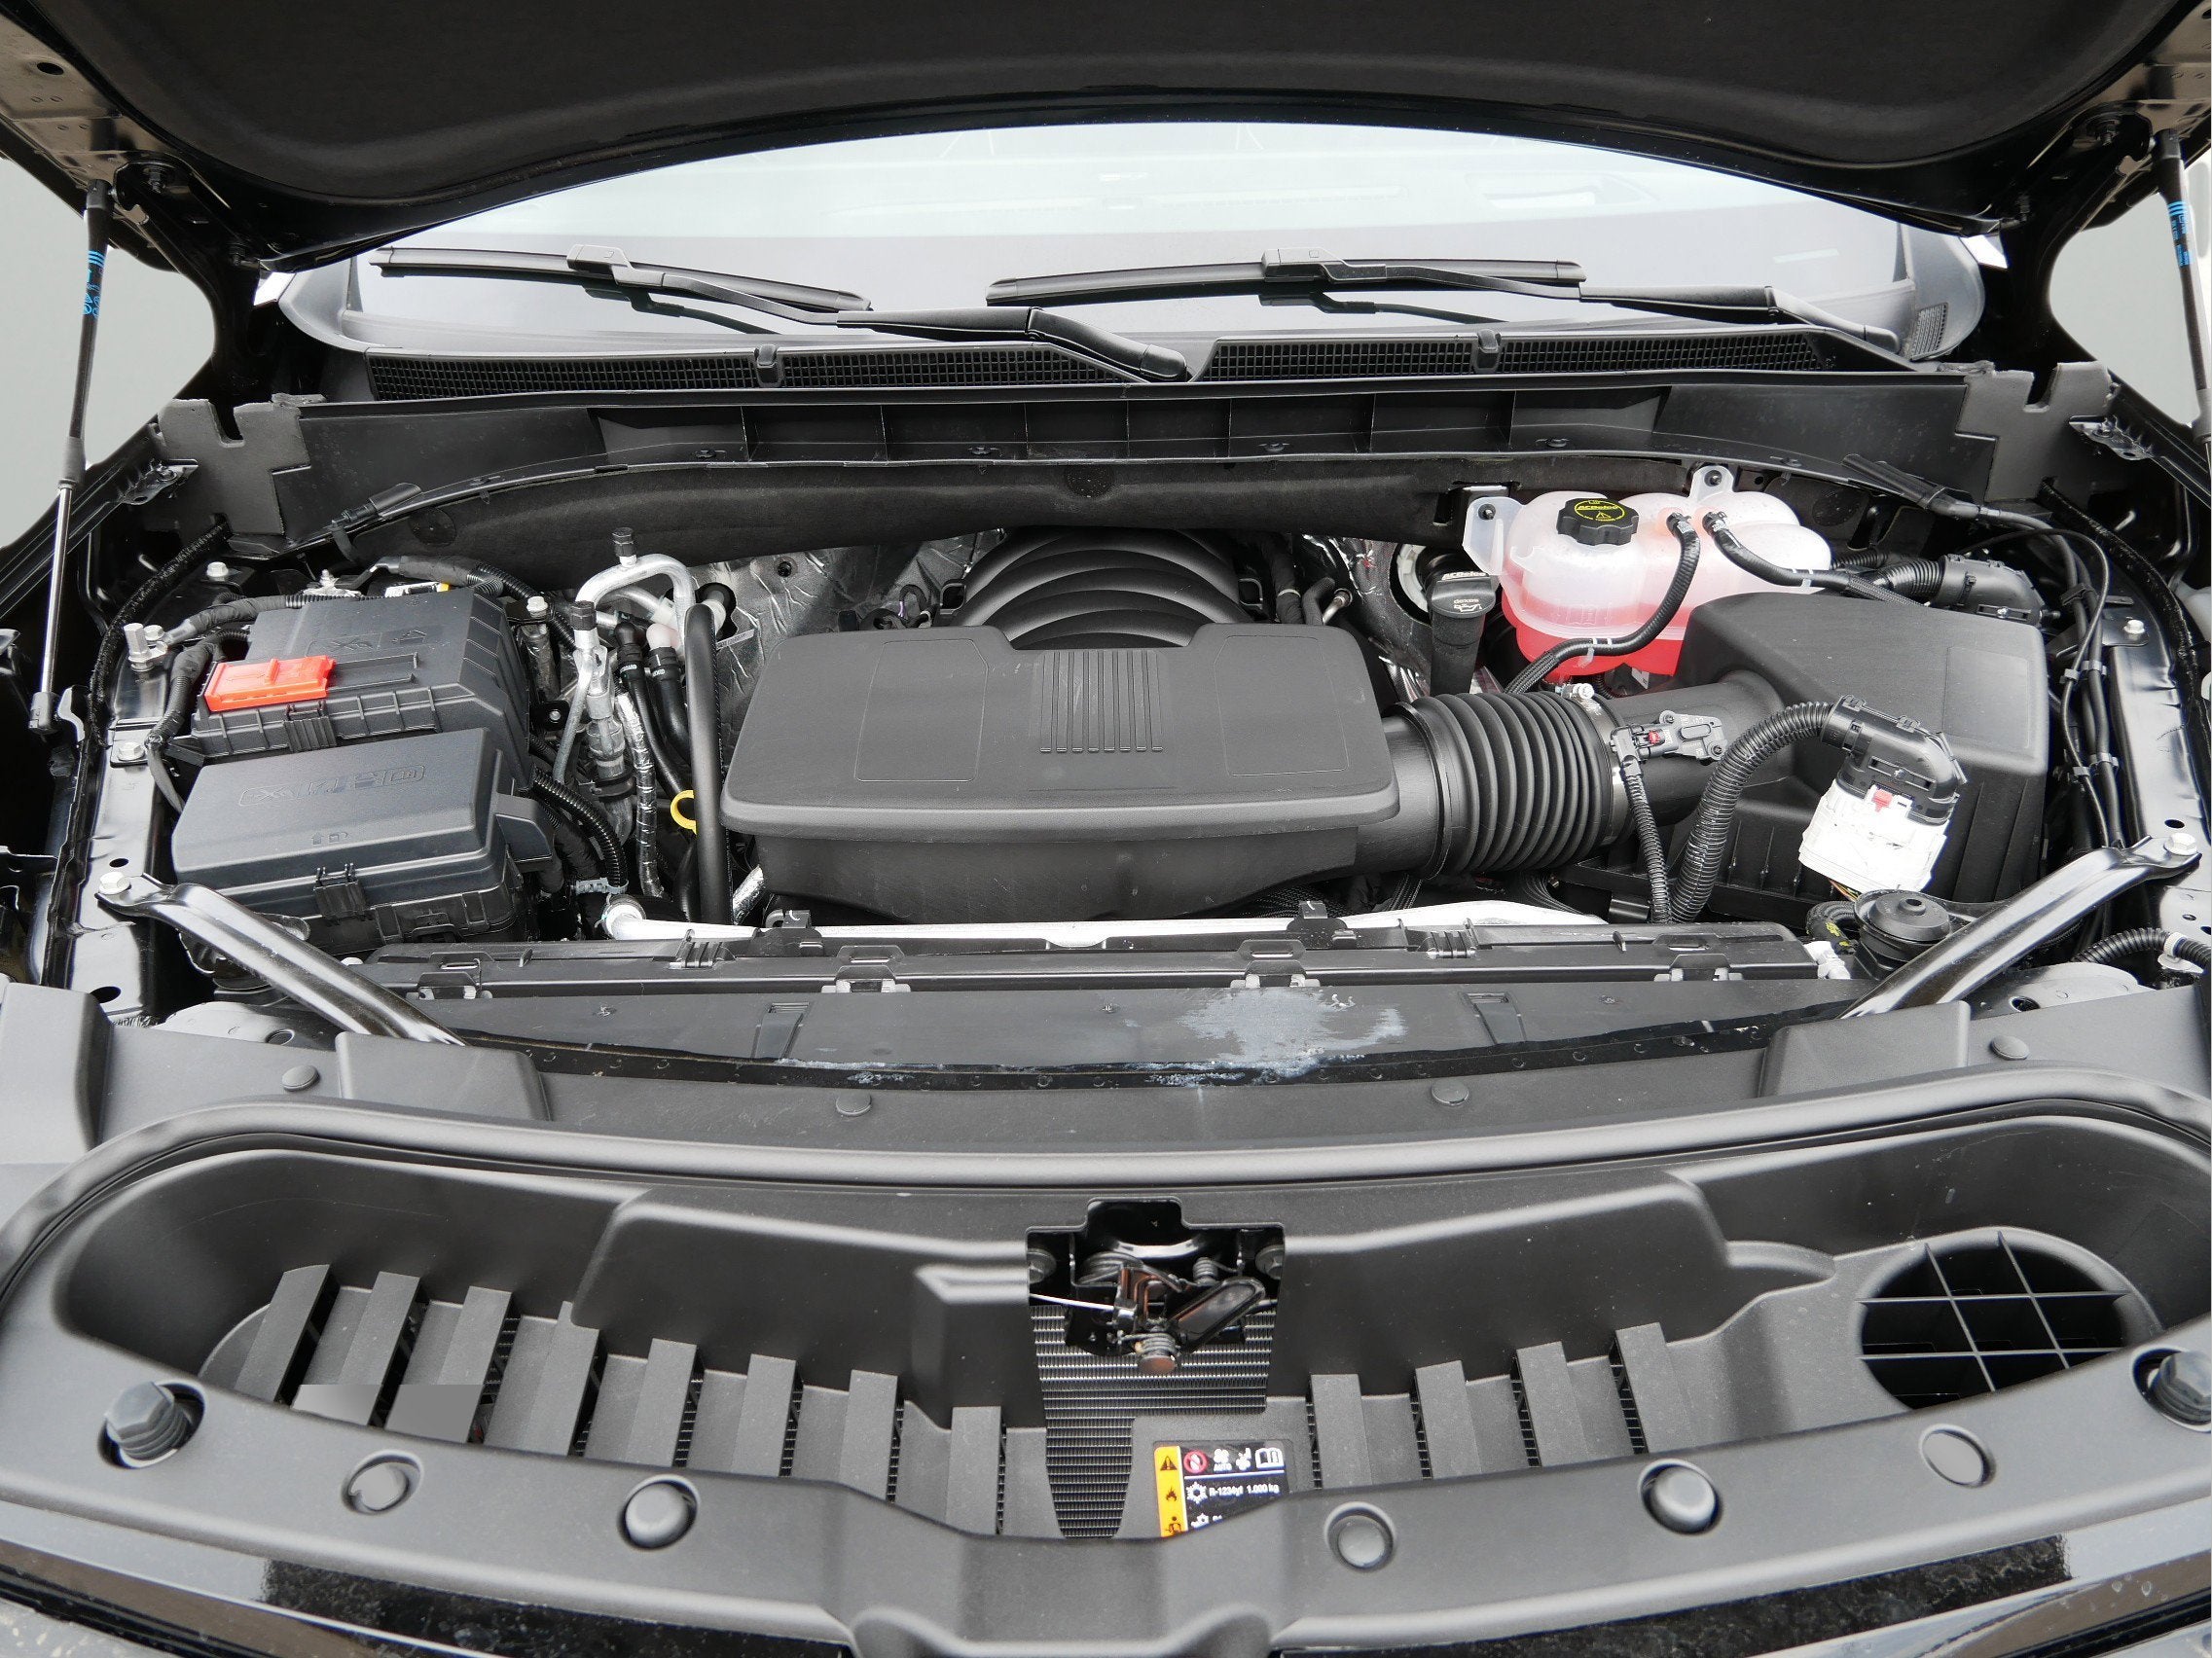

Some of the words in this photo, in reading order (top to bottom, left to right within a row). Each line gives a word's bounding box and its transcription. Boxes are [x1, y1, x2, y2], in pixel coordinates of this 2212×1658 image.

[1441, 571, 1487, 580] ACDelco
[1209, 1485, 1244, 1496] R-1234yf
[1247, 1484, 1268, 1494] 1.000
[1268, 1483, 1280, 1494] kg
